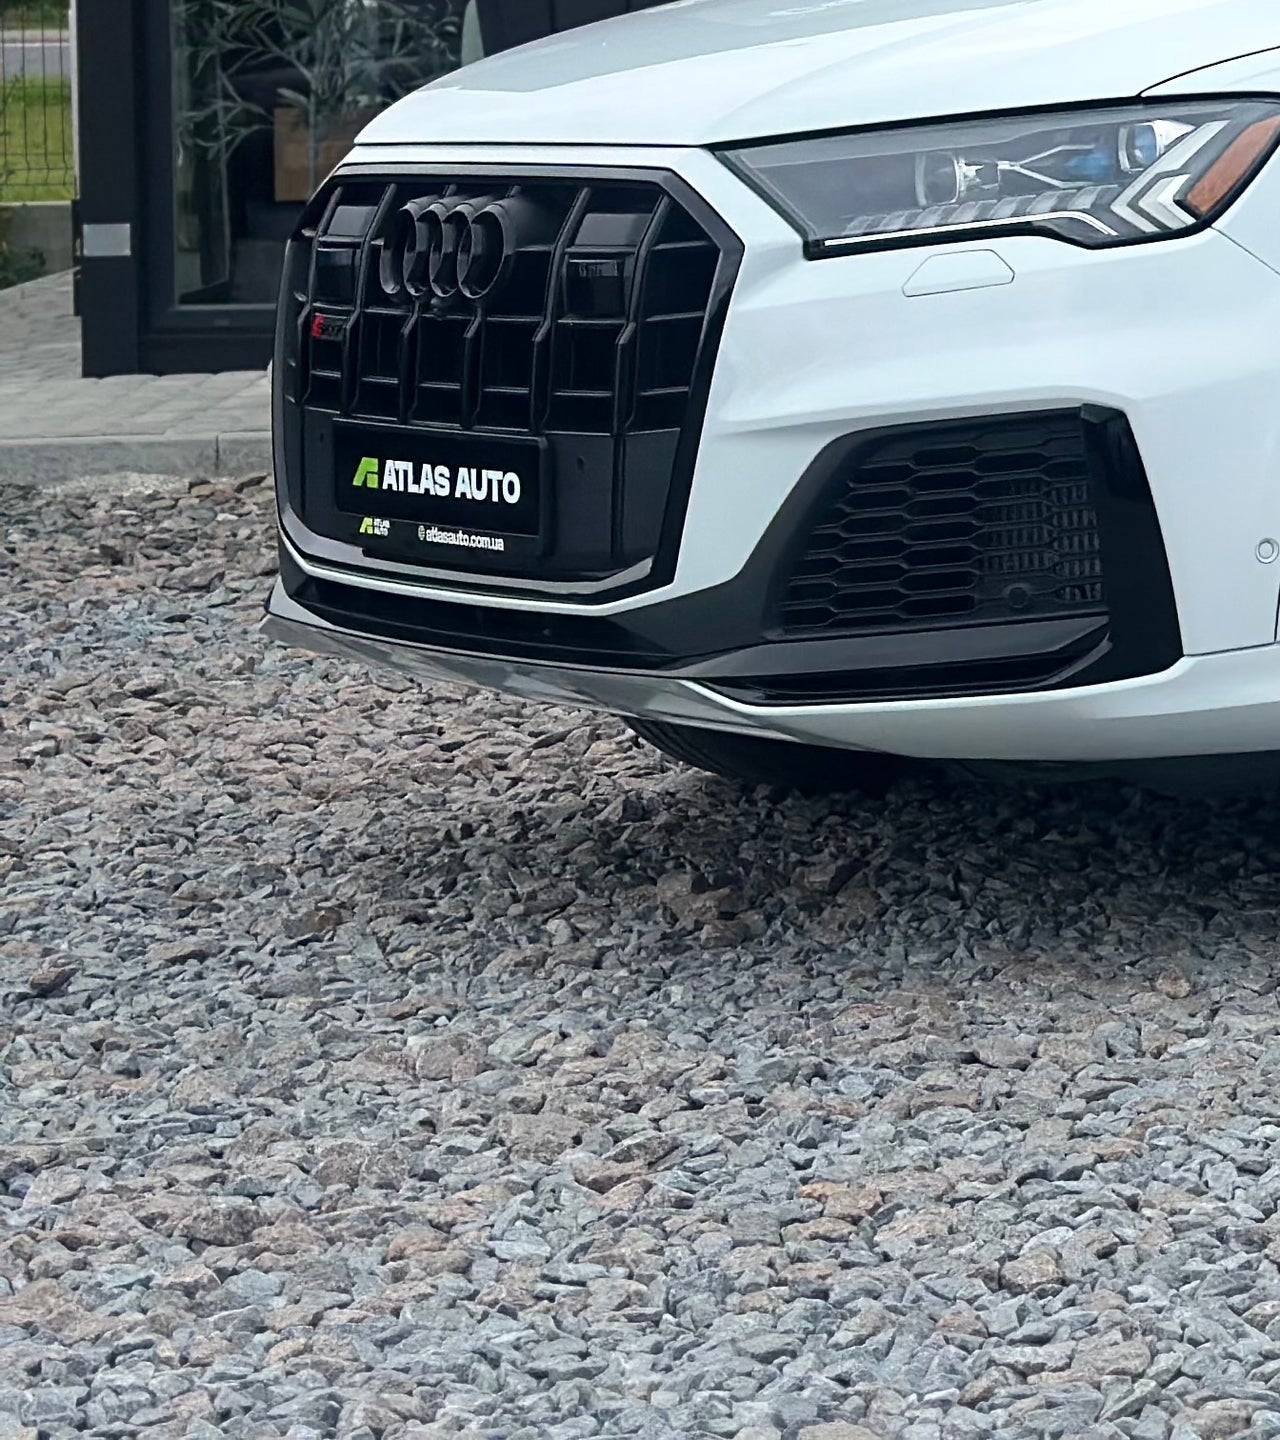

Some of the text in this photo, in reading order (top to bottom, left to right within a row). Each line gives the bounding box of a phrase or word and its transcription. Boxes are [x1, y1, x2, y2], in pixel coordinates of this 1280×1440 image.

[382, 459, 521, 504] ATLAS AUTO
[426, 527, 505, 551] atlasauto.com.ua
